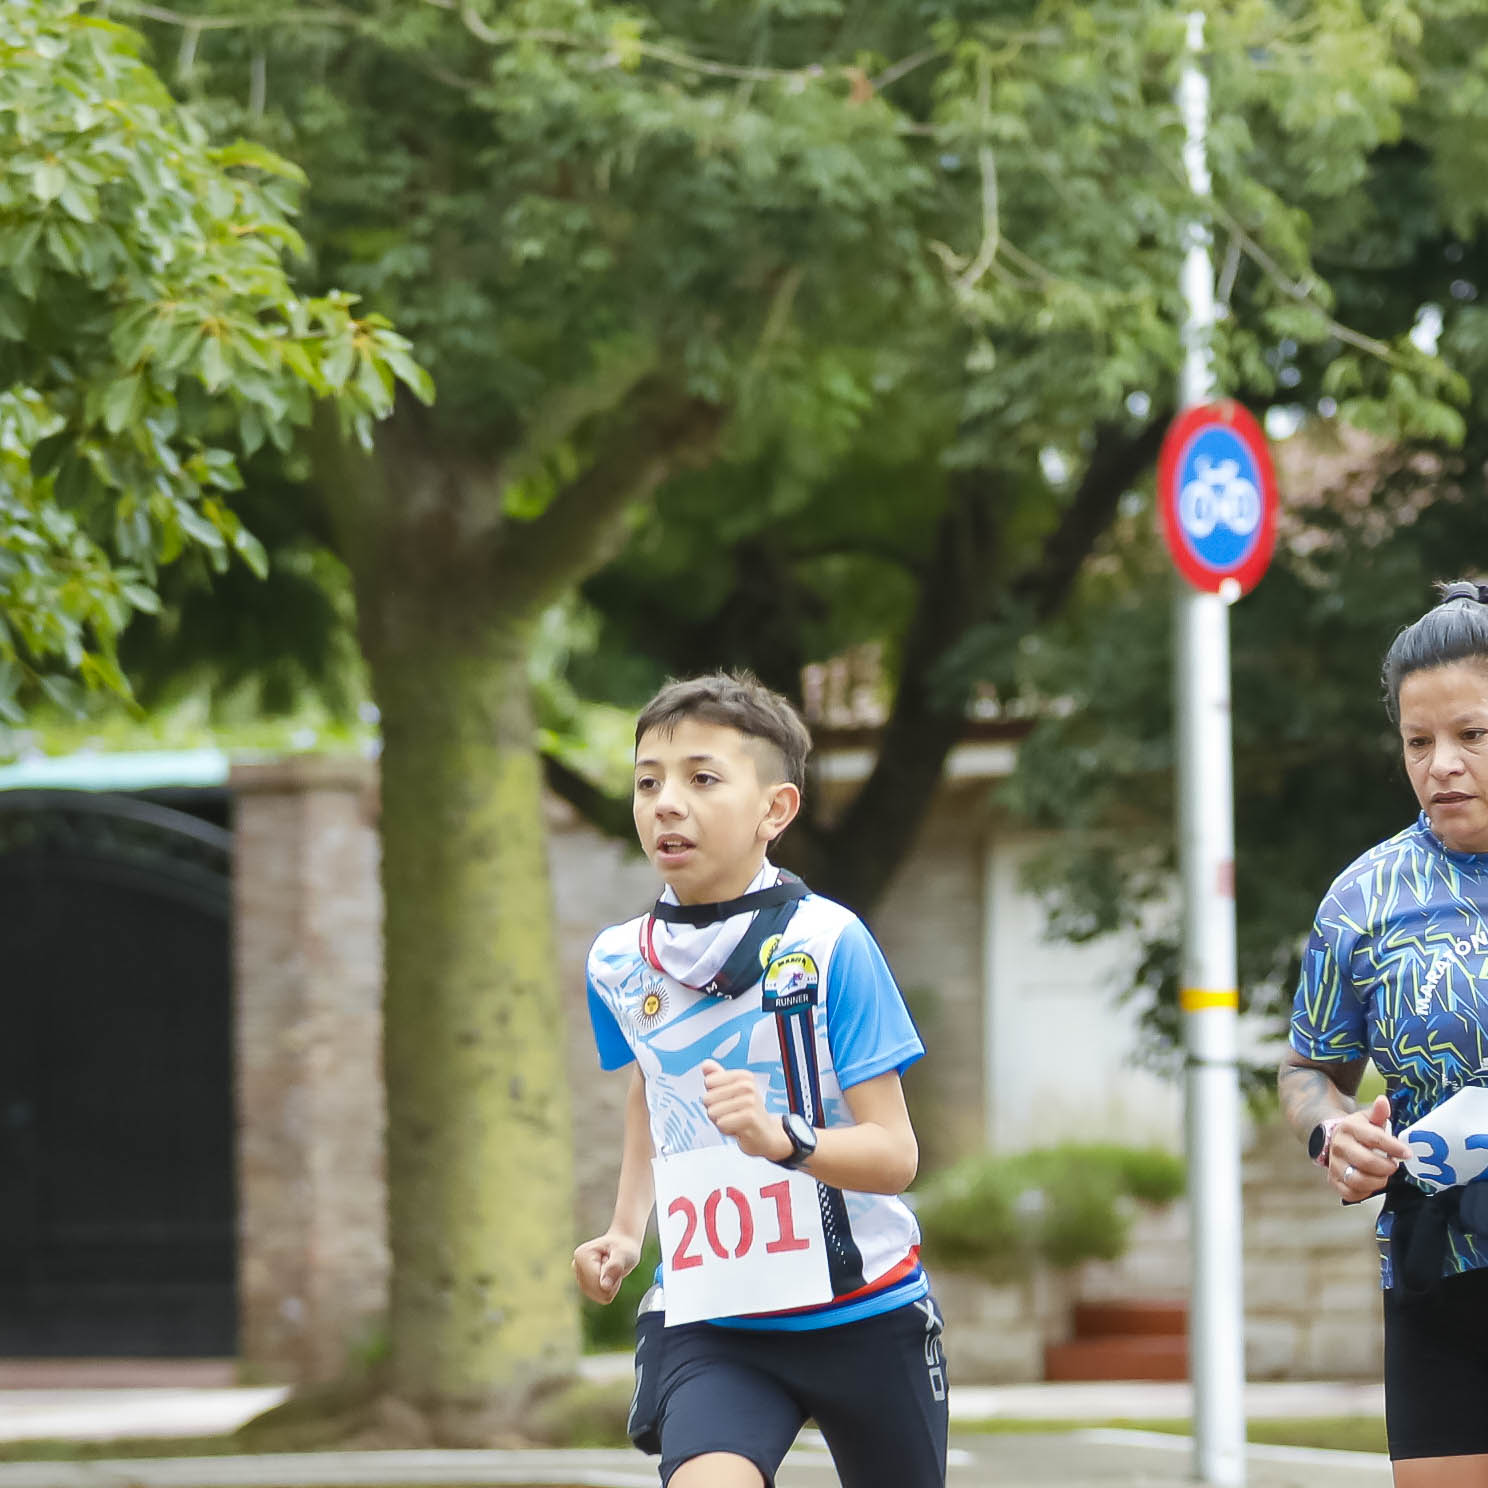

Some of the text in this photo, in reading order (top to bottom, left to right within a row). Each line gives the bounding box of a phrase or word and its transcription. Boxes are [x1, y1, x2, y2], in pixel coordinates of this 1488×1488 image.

[775, 993, 809, 1007] RUNNER
[1415, 931, 1488, 1016] MARATÓN
[668, 1179, 811, 1272] 201
